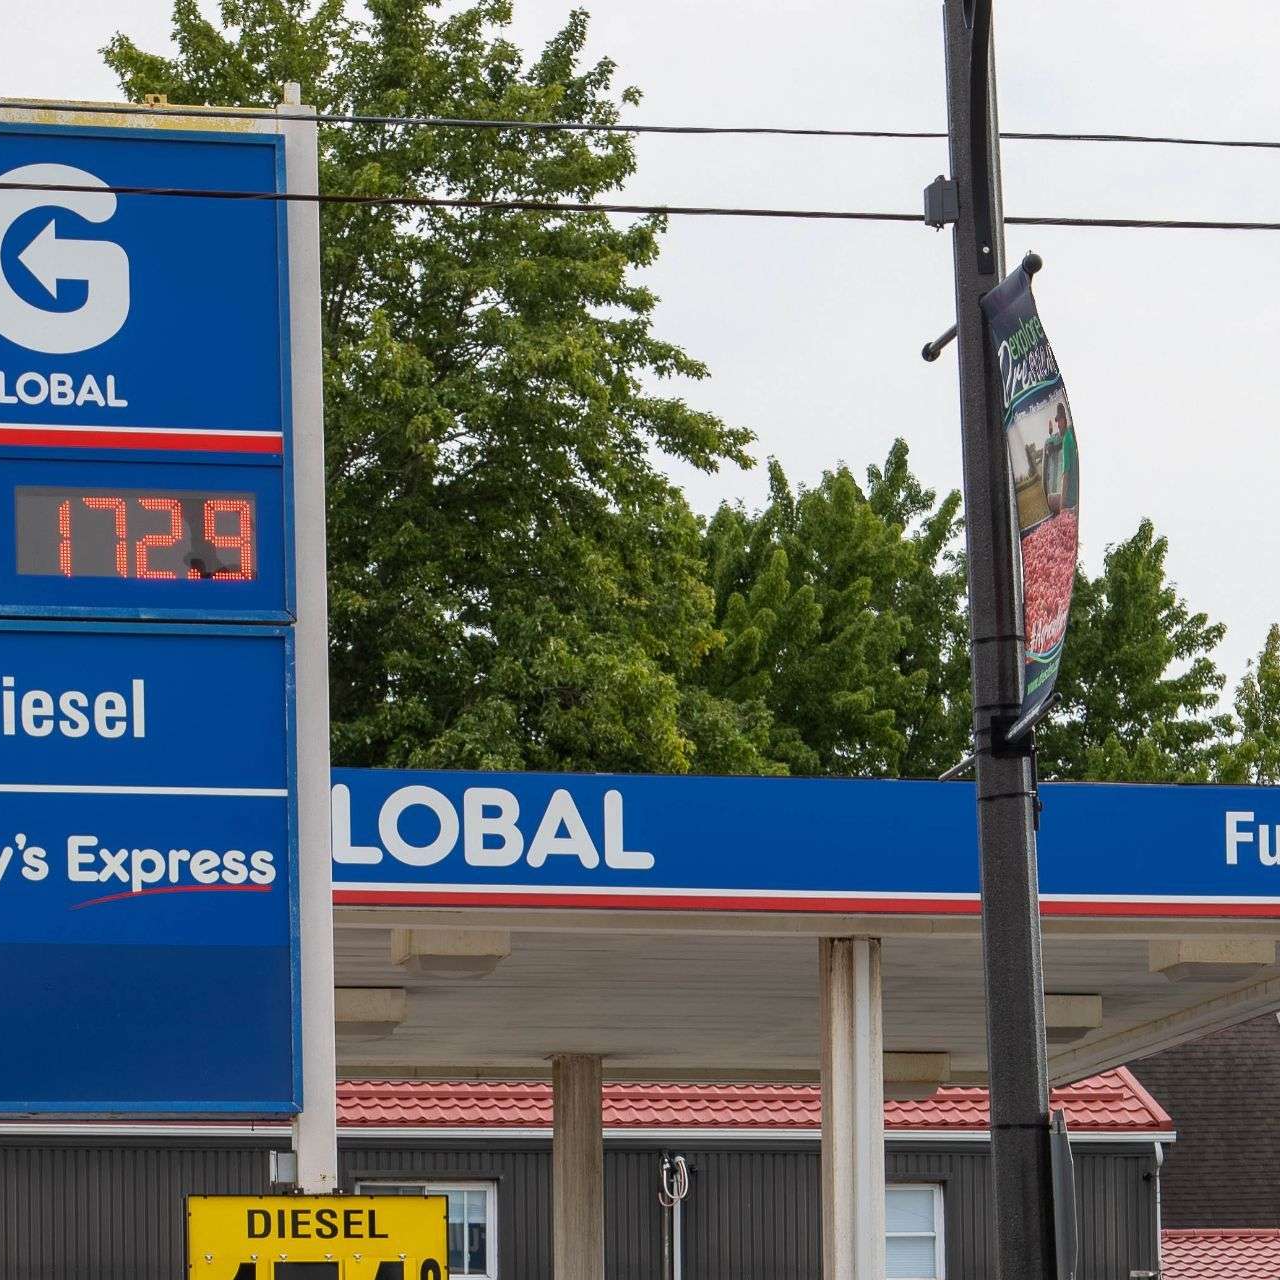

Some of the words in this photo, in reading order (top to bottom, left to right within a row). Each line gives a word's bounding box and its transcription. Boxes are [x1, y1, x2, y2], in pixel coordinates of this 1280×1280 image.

[57, 496, 252, 581] 172.9
[332, 783, 655, 869] LOBAL
[67, 835, 276, 893] Express
[247, 1208, 389, 1239] DIESEL
